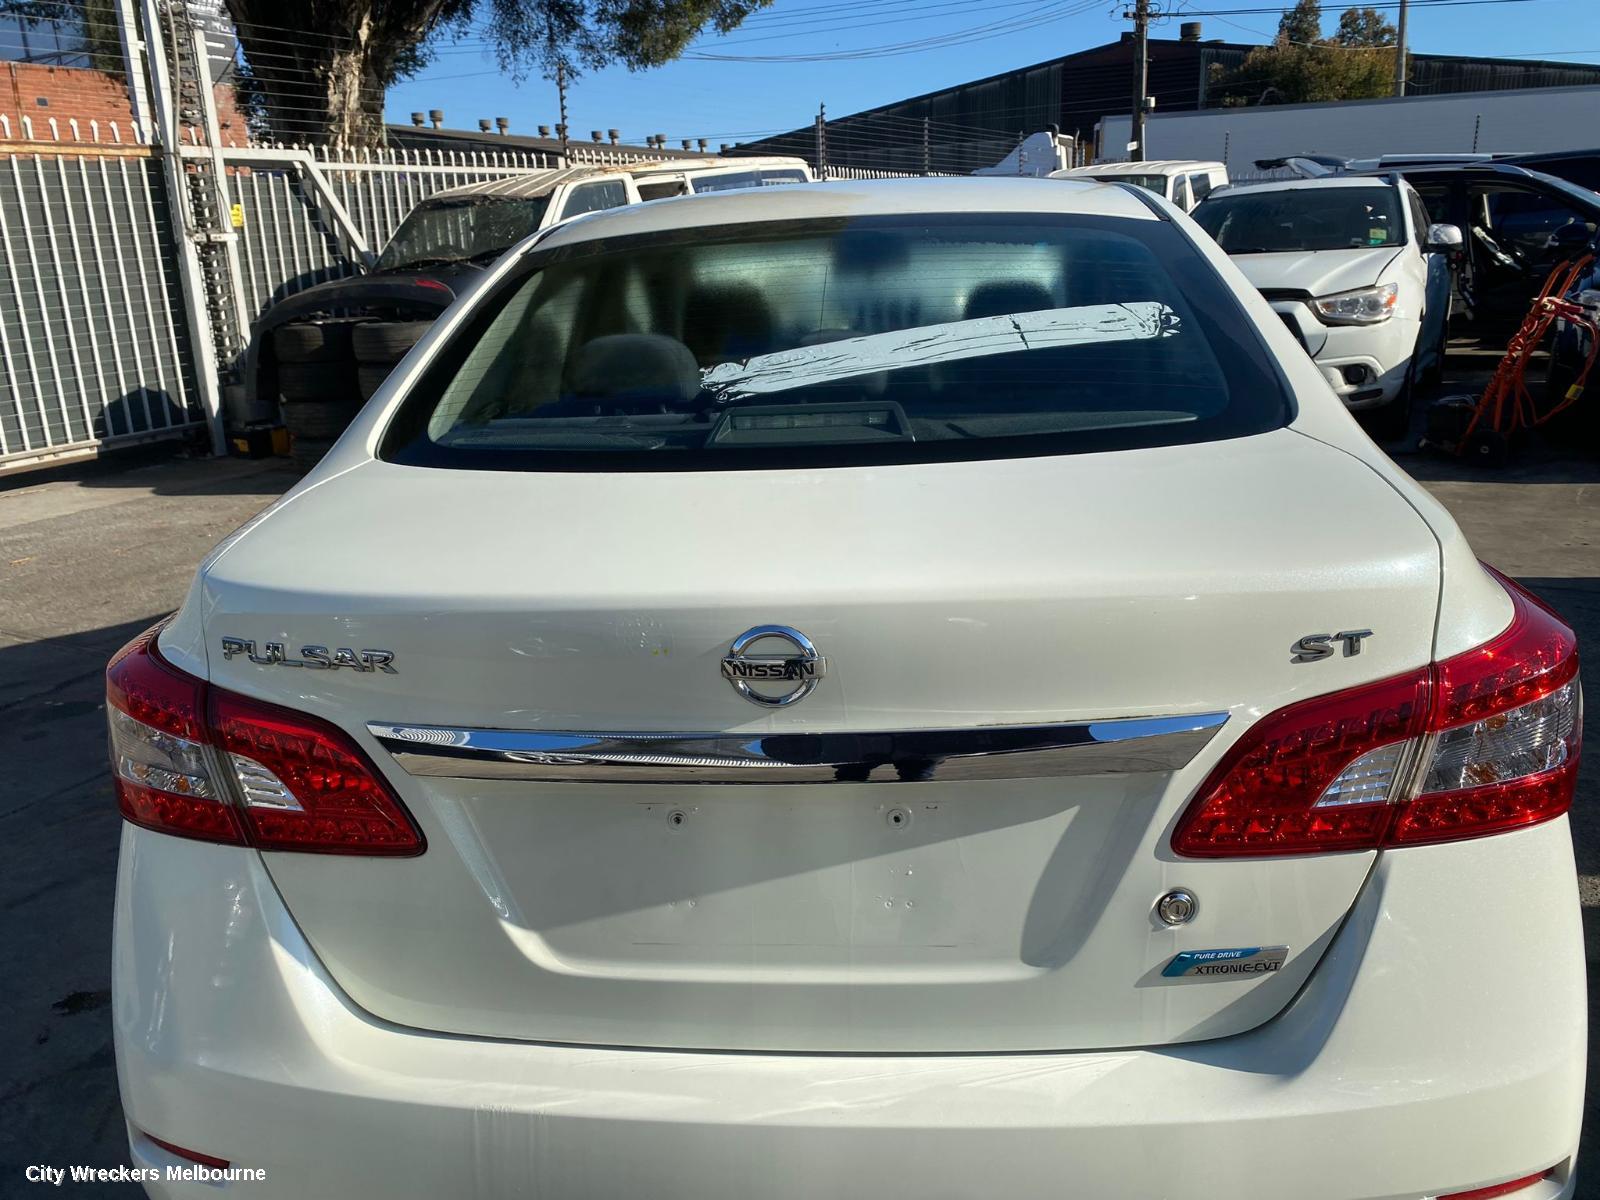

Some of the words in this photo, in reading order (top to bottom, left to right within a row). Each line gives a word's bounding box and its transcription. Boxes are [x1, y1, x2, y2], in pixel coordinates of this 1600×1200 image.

[222, 636, 399, 674] PULSAR
[1290, 629, 1374, 664] ST
[732, 662, 815, 678] NISSAN
[1194, 952, 1216, 960] PURE
[1216, 951, 1242, 959] DRIVE
